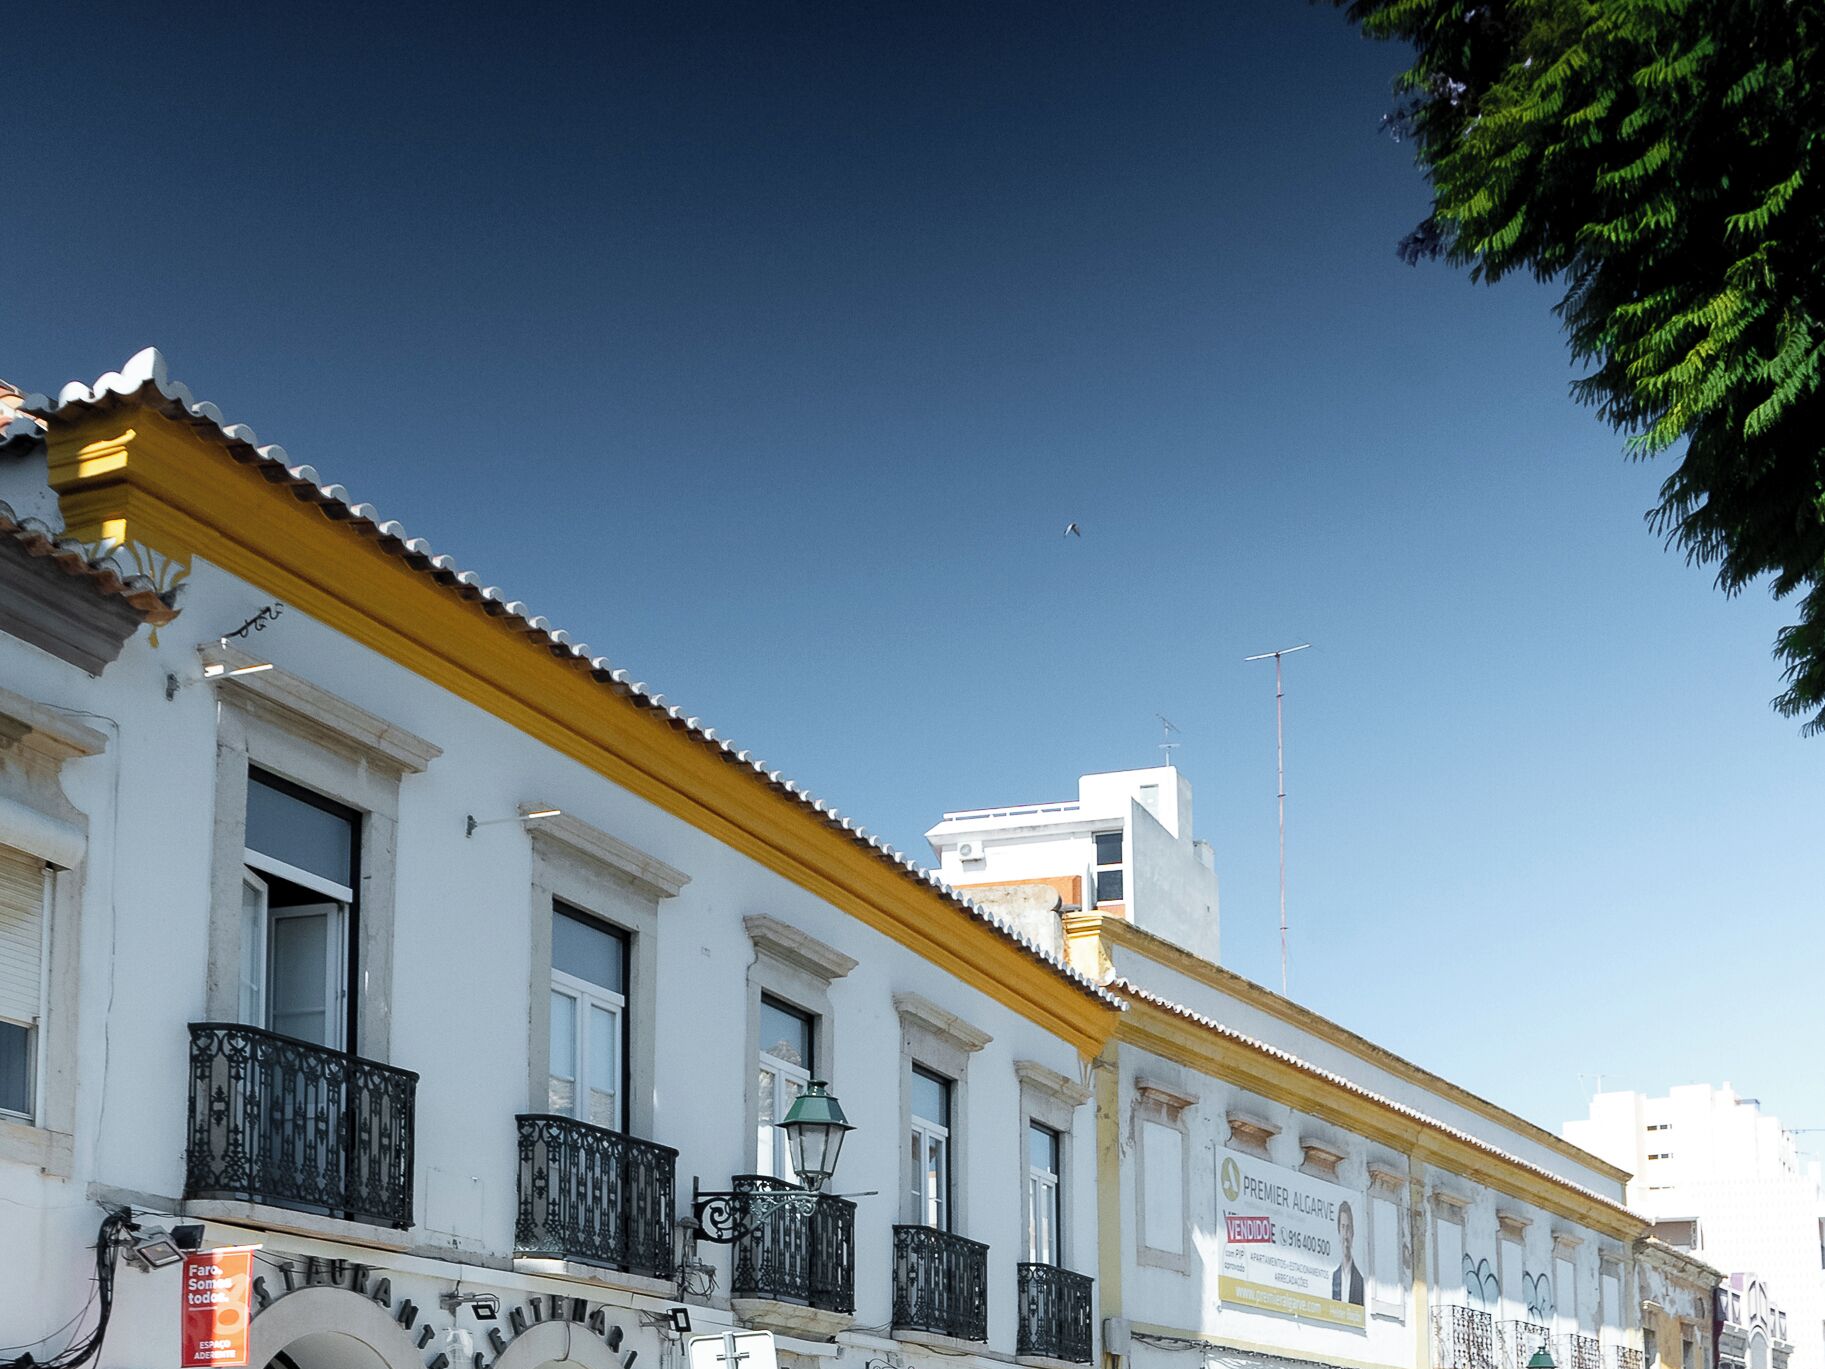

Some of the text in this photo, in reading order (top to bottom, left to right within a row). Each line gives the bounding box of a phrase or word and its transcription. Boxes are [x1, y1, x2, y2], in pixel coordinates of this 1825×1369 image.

[1243, 1176, 1289, 1208] PREMIER
[1293, 1192, 1335, 1221] ALGARVE
[1228, 1219, 1270, 1241] VENDIDO
[1288, 1230, 1301, 1249] 916
[189, 1265, 223, 1276] Faro.
[188, 1278, 232, 1290] Somos
[188, 1292, 229, 1304] todos.
